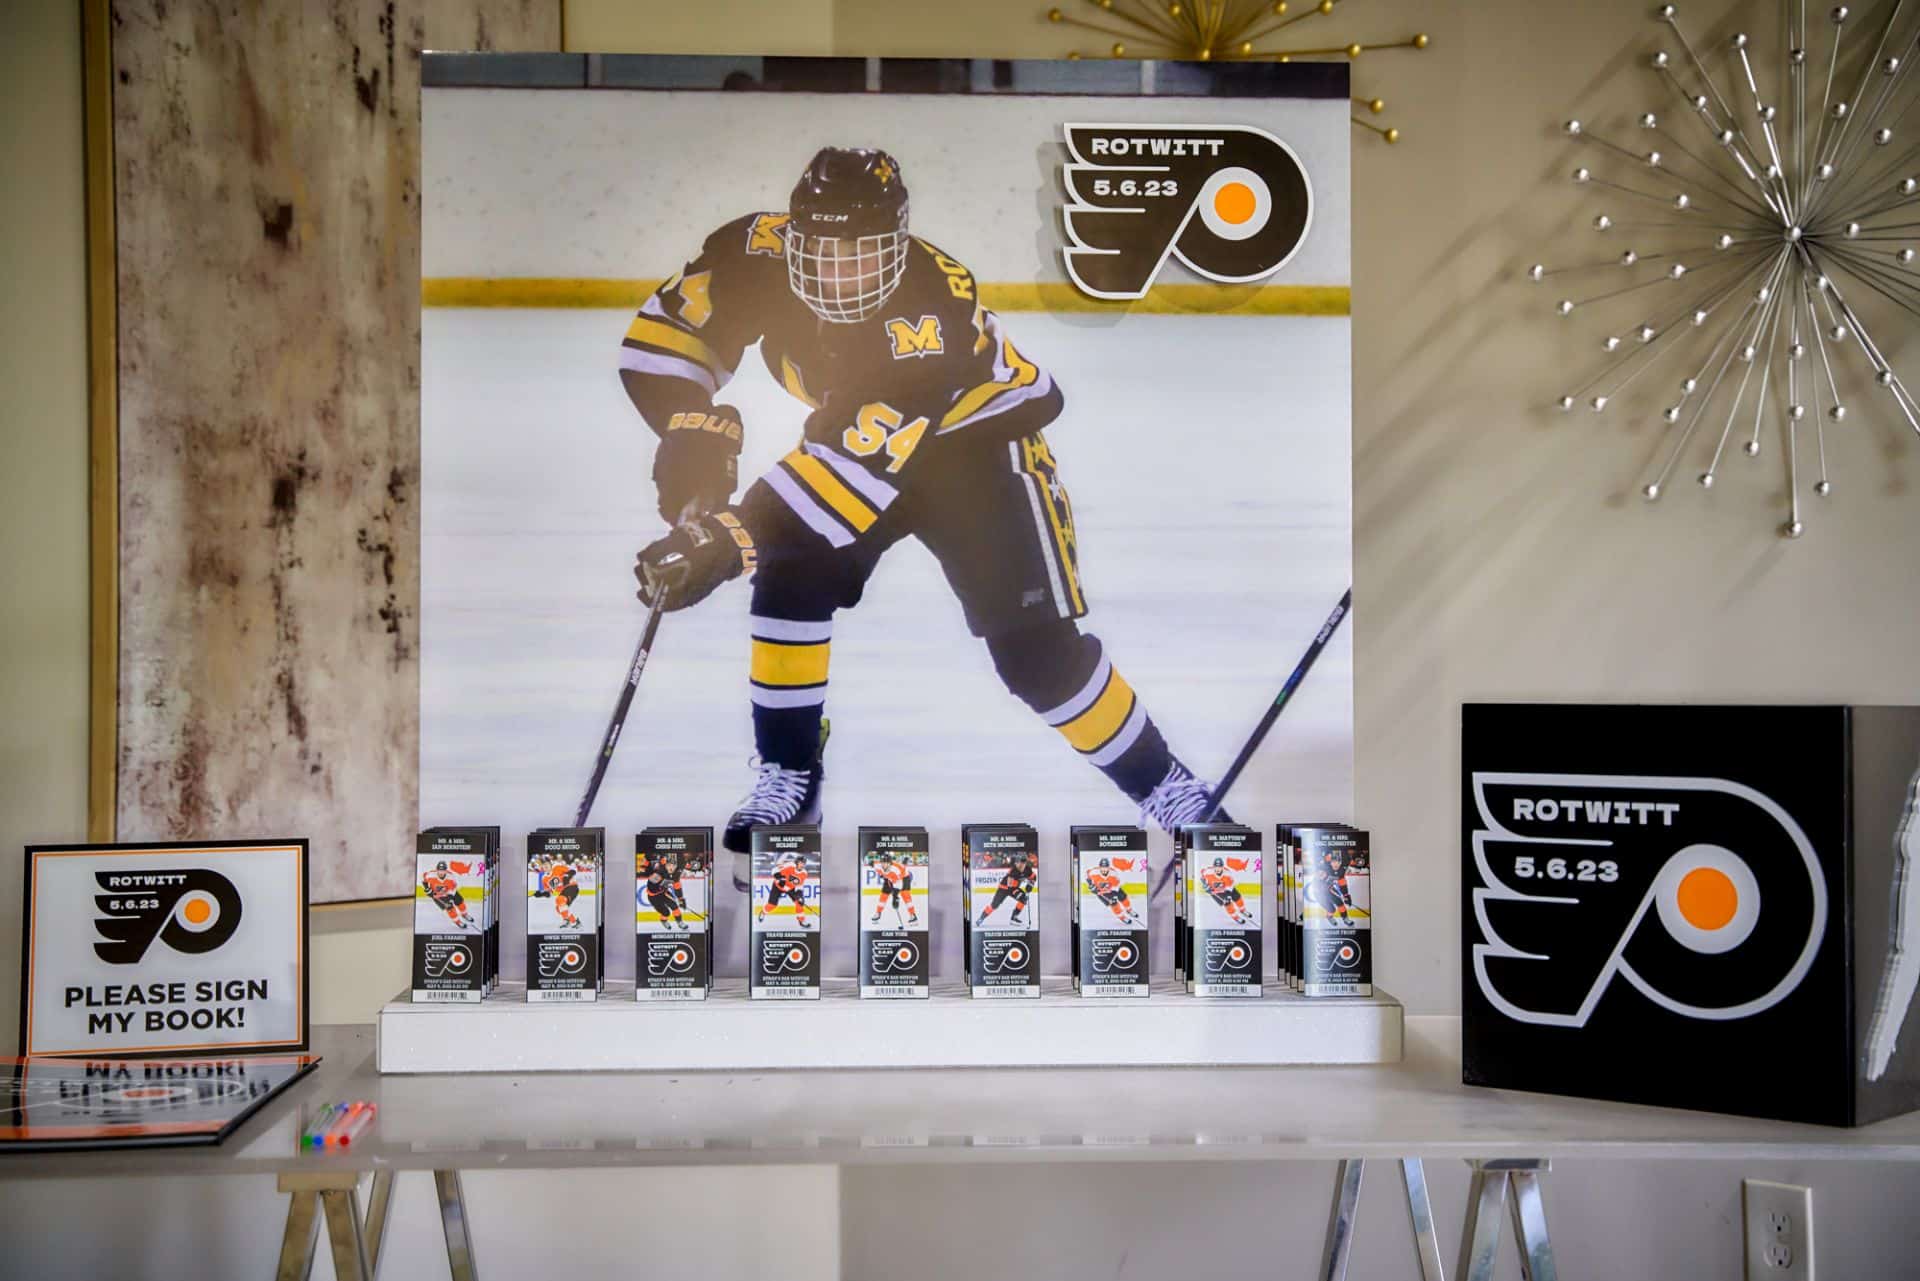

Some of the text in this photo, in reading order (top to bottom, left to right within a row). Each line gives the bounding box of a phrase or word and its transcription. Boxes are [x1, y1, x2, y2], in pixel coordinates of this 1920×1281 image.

[1091, 138, 1225, 156] ROTWITT
[1093, 179, 1179, 196] 5.6.23
[811, 213, 849, 222] CCM
[885, 315, 944, 358] M
[668, 412, 742, 441] BAUE
[843, 402, 930, 474] 54
[1512, 798, 1680, 826] ROTWITT
[109, 874, 187, 887] ROTWITT
[1514, 856, 1620, 883] 5.6.23
[109, 899, 160, 910] 5.6.23
[64, 979, 268, 1008] PLEASE SIGN
[88, 1007, 245, 1034] MY BOOK!
